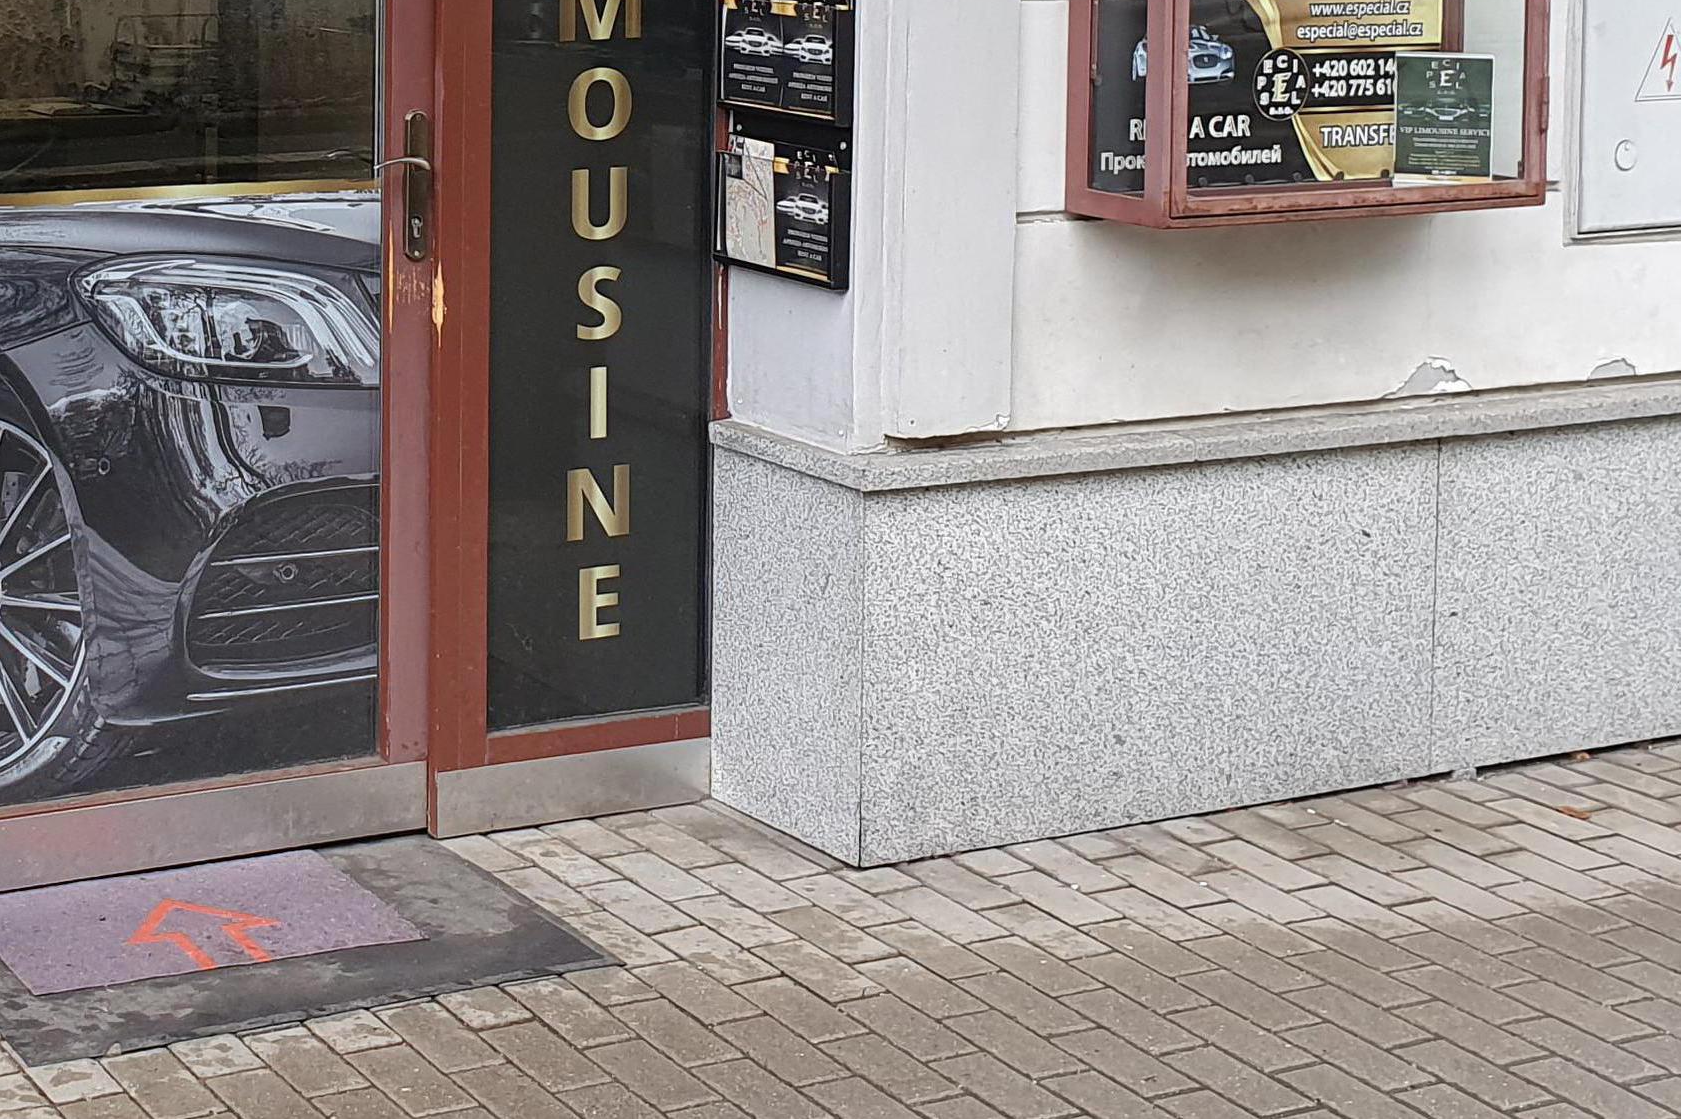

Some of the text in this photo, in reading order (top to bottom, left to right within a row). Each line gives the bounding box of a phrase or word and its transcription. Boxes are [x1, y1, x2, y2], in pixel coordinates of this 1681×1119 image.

[1297, 22, 1424, 42] especial@especial.cz
[1312, 57, 1397, 79] +420 602 14
[1311, 79, 1347, 99] +420
[1349, 79, 1373, 98] 775
[1189, 115, 1251, 140] A CAR
